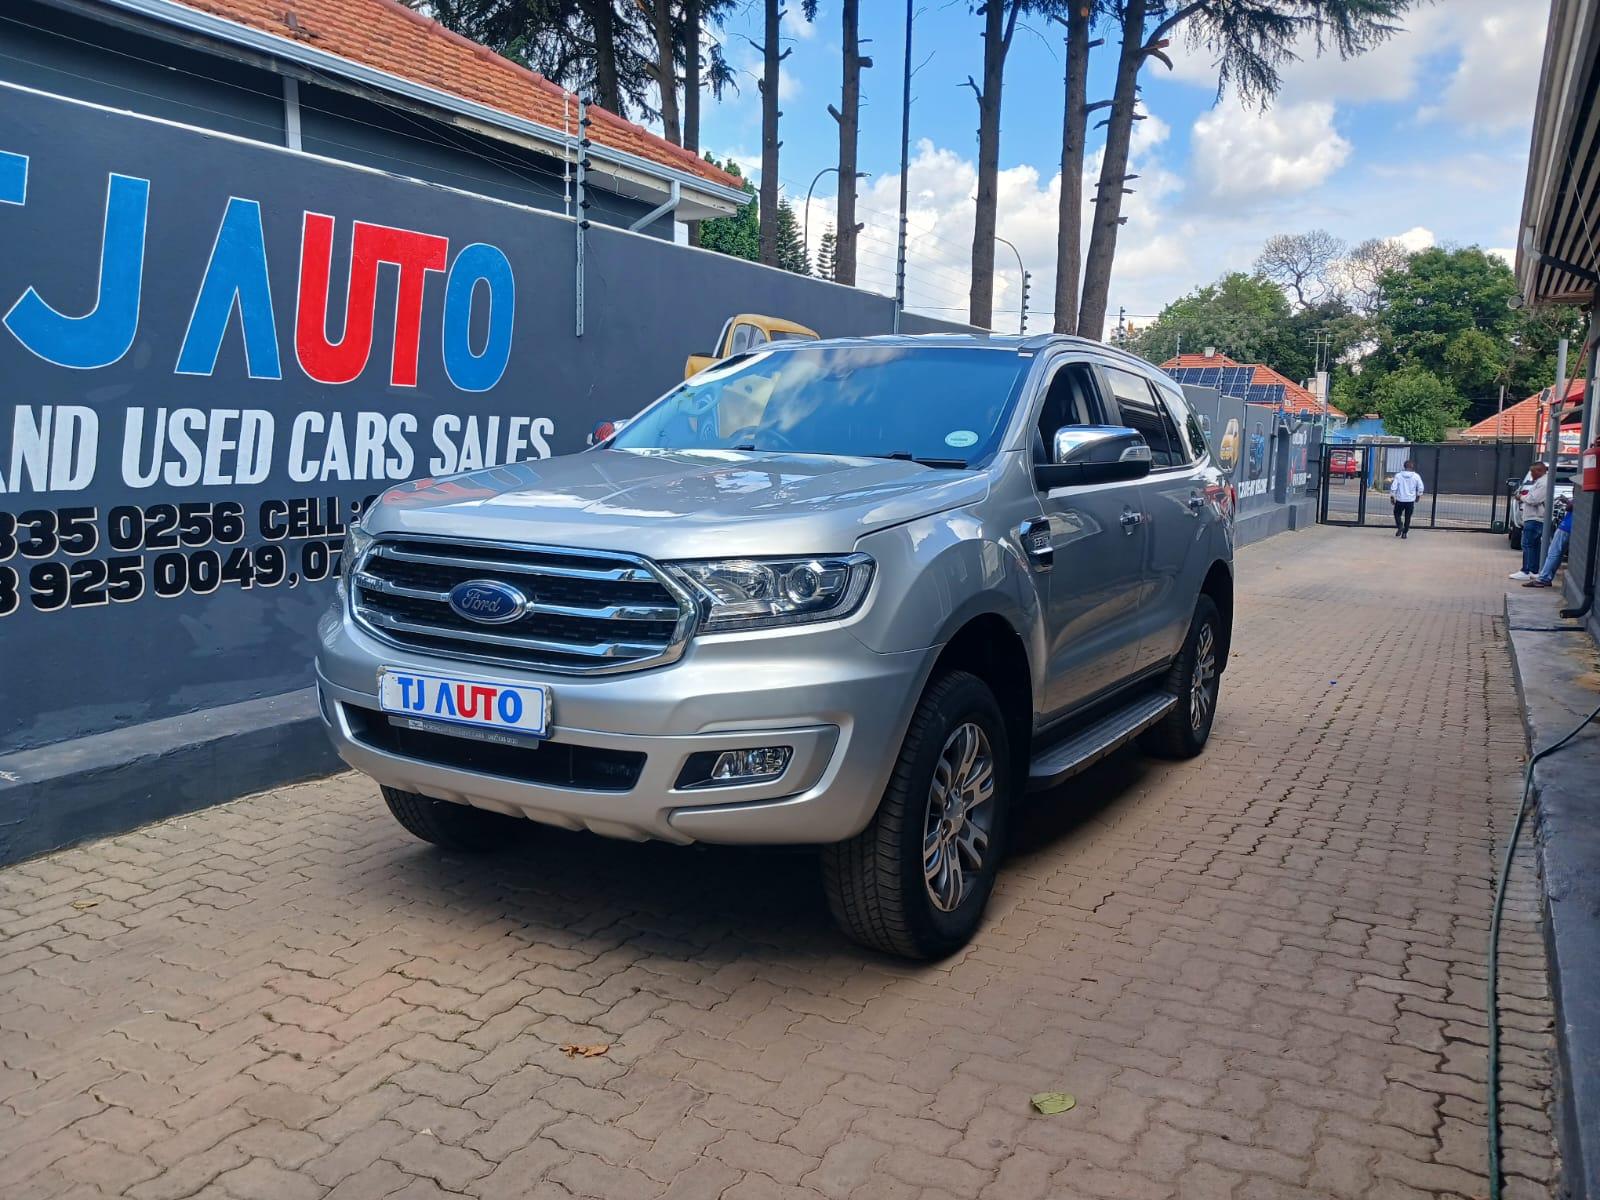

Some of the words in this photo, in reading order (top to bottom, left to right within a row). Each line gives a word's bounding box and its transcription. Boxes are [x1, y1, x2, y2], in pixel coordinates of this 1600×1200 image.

[0, 150, 150, 369] J
[174, 195, 515, 392] AUTO
[0, 405, 99, 493] ND
[121, 407, 275, 488] USED
[288, 411, 417, 482] CARS
[429, 414, 555, 476] SALES
[108, 503, 244, 552] 0256
[29, 555, 145, 612] 925
[461, 588, 502, 612] Ford
[397, 676, 425, 711] TJ
[435, 682, 523, 724] AUTO
